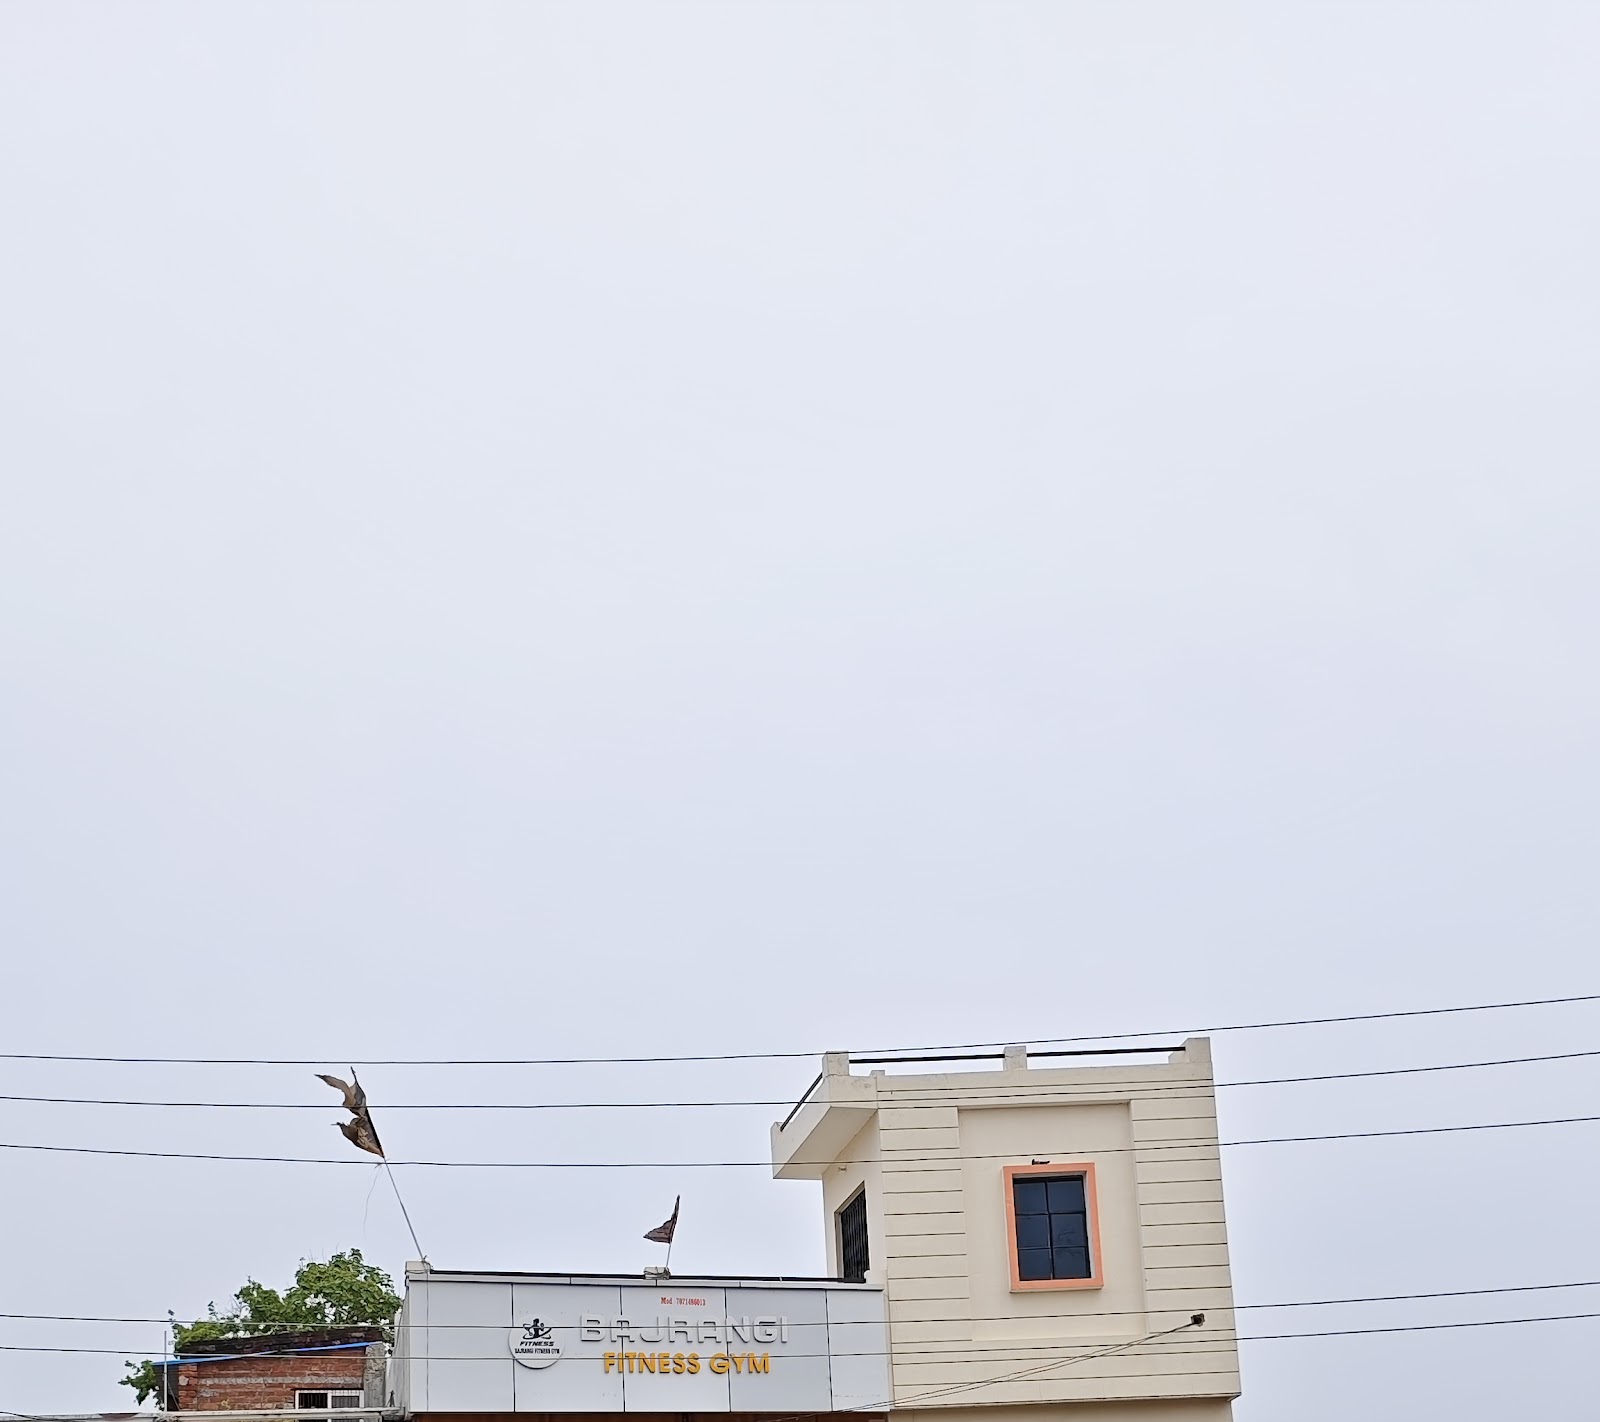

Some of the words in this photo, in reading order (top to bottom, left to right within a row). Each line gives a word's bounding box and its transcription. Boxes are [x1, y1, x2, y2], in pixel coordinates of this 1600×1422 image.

[580, 1314, 788, 1343] BAJRANGI
[603, 1352, 701, 1374] FITNESS
[709, 1352, 770, 1374] GYM
